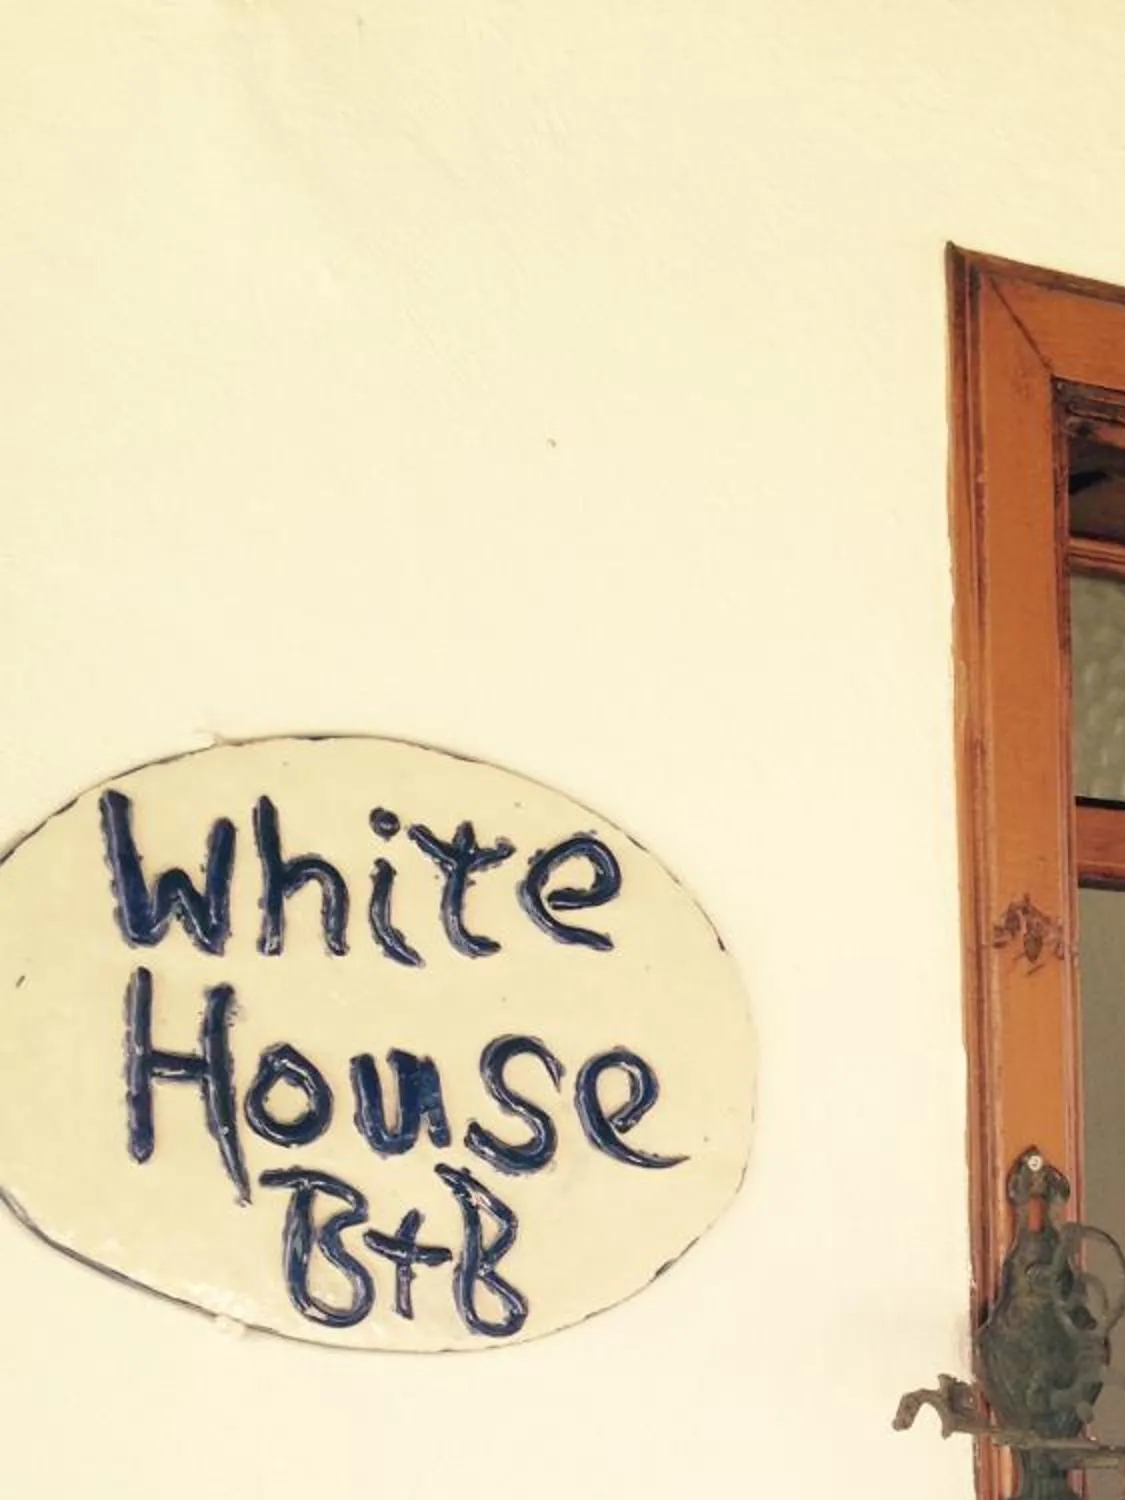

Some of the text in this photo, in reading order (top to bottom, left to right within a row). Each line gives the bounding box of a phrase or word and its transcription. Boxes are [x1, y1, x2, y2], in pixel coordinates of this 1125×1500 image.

[101, 789, 622, 967] White
[122, 966, 690, 1206] House
[260, 1164, 529, 1337] B+B
